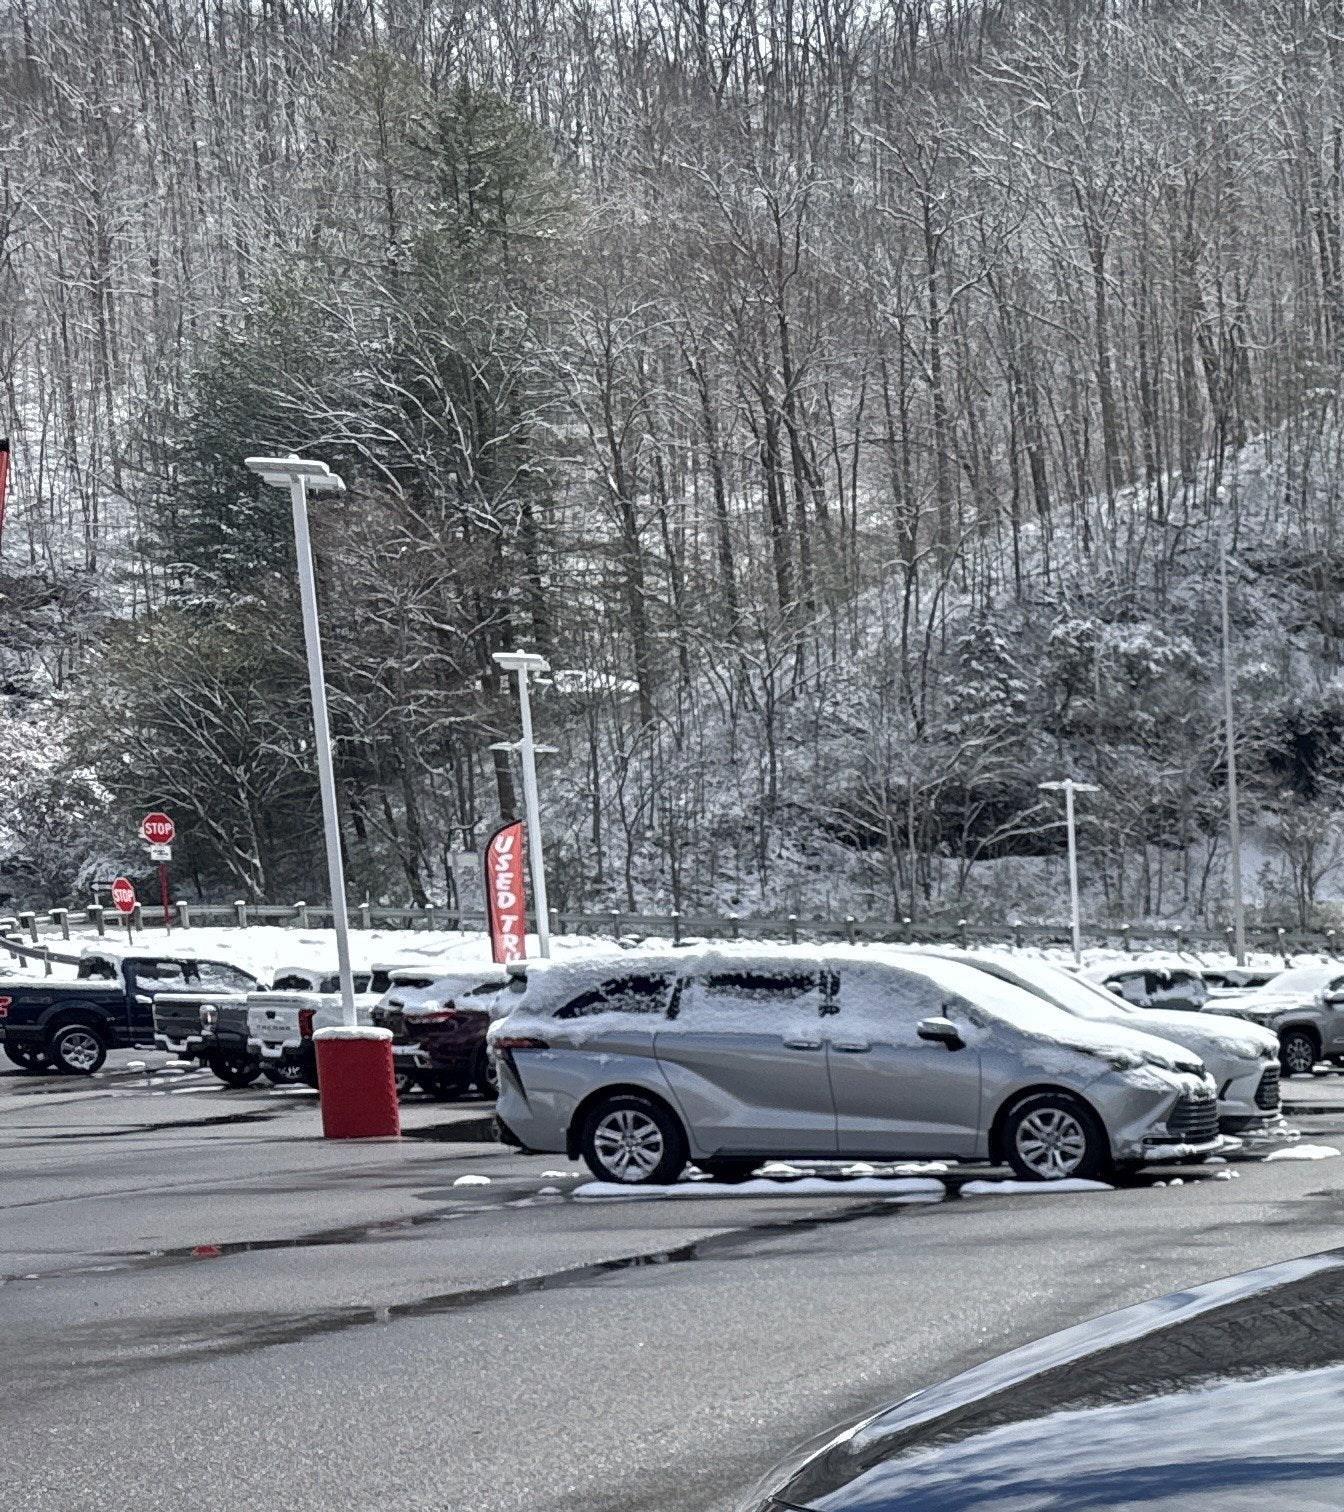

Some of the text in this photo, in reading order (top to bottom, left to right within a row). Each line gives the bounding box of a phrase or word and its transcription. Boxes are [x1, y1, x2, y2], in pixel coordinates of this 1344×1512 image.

[145, 822, 172, 835] STOP
[495, 834, 516, 909] USED
[113, 888, 133, 903] STOP
